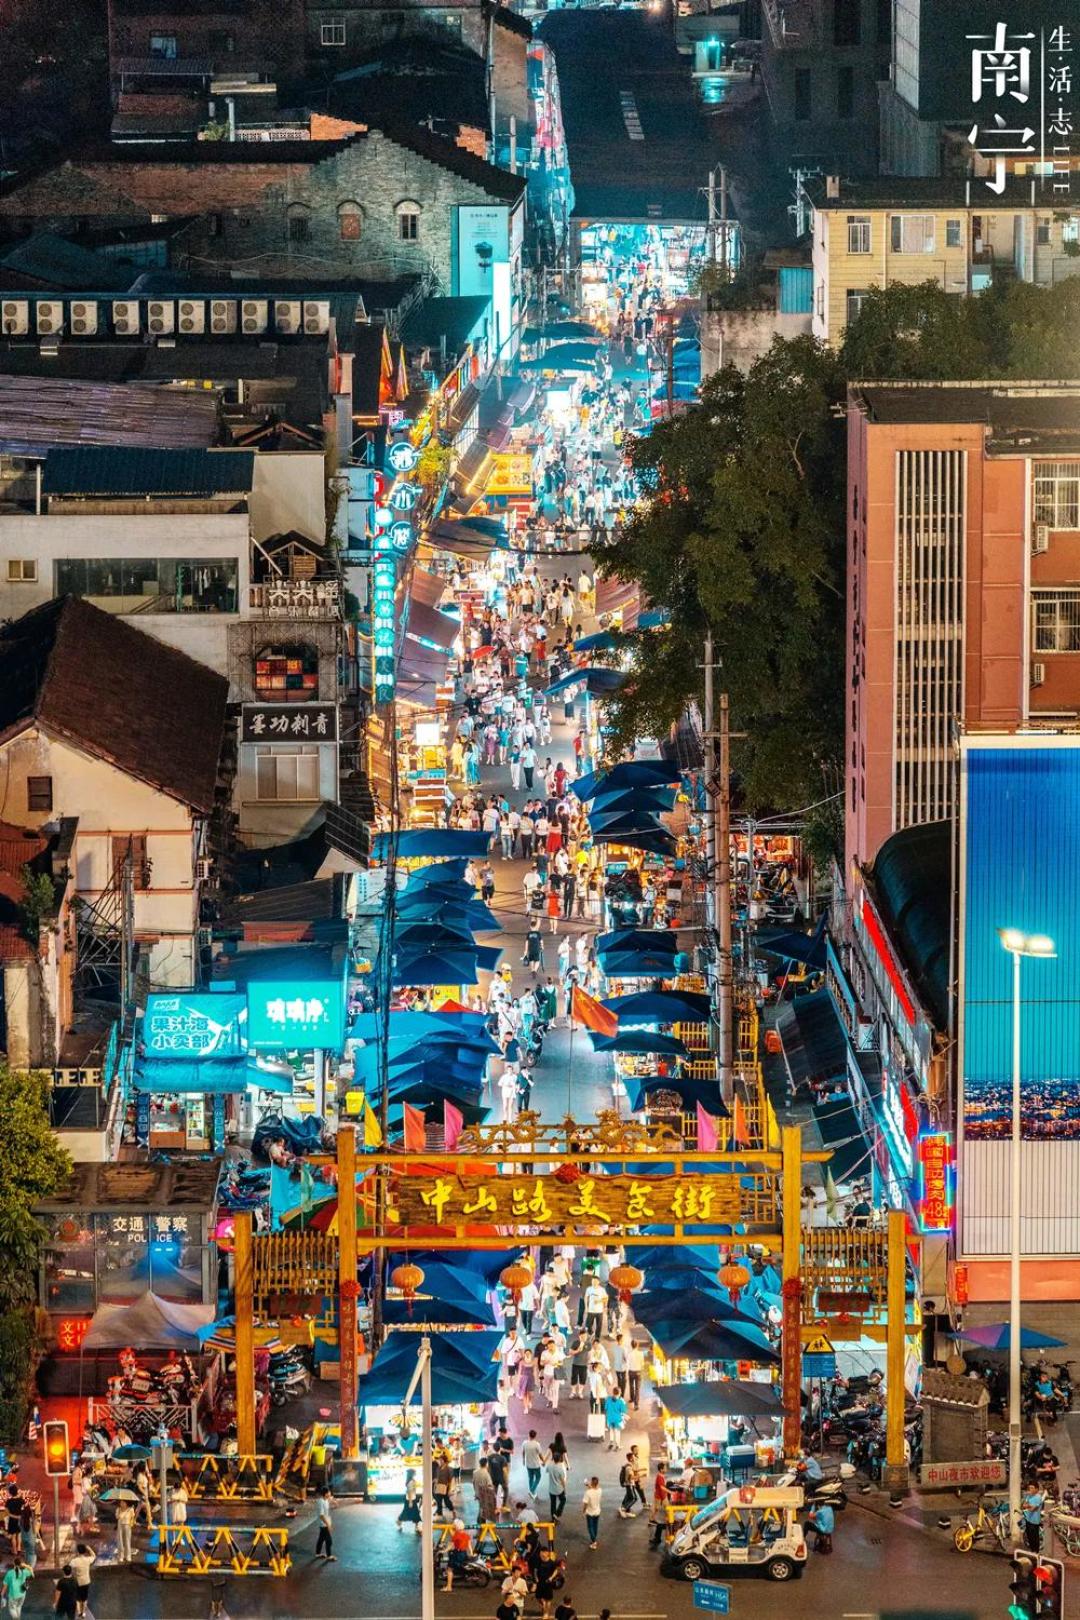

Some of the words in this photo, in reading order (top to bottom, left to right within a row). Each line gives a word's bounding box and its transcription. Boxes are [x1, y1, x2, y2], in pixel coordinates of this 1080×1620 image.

[249, 712, 328, 736] 墨功刺青
[152, 1033, 211, 1050] 小卖部
[419, 1180, 717, 1224] 中山路美食街
[928, 1463, 1002, 1482] 中山夜市欢迎您
